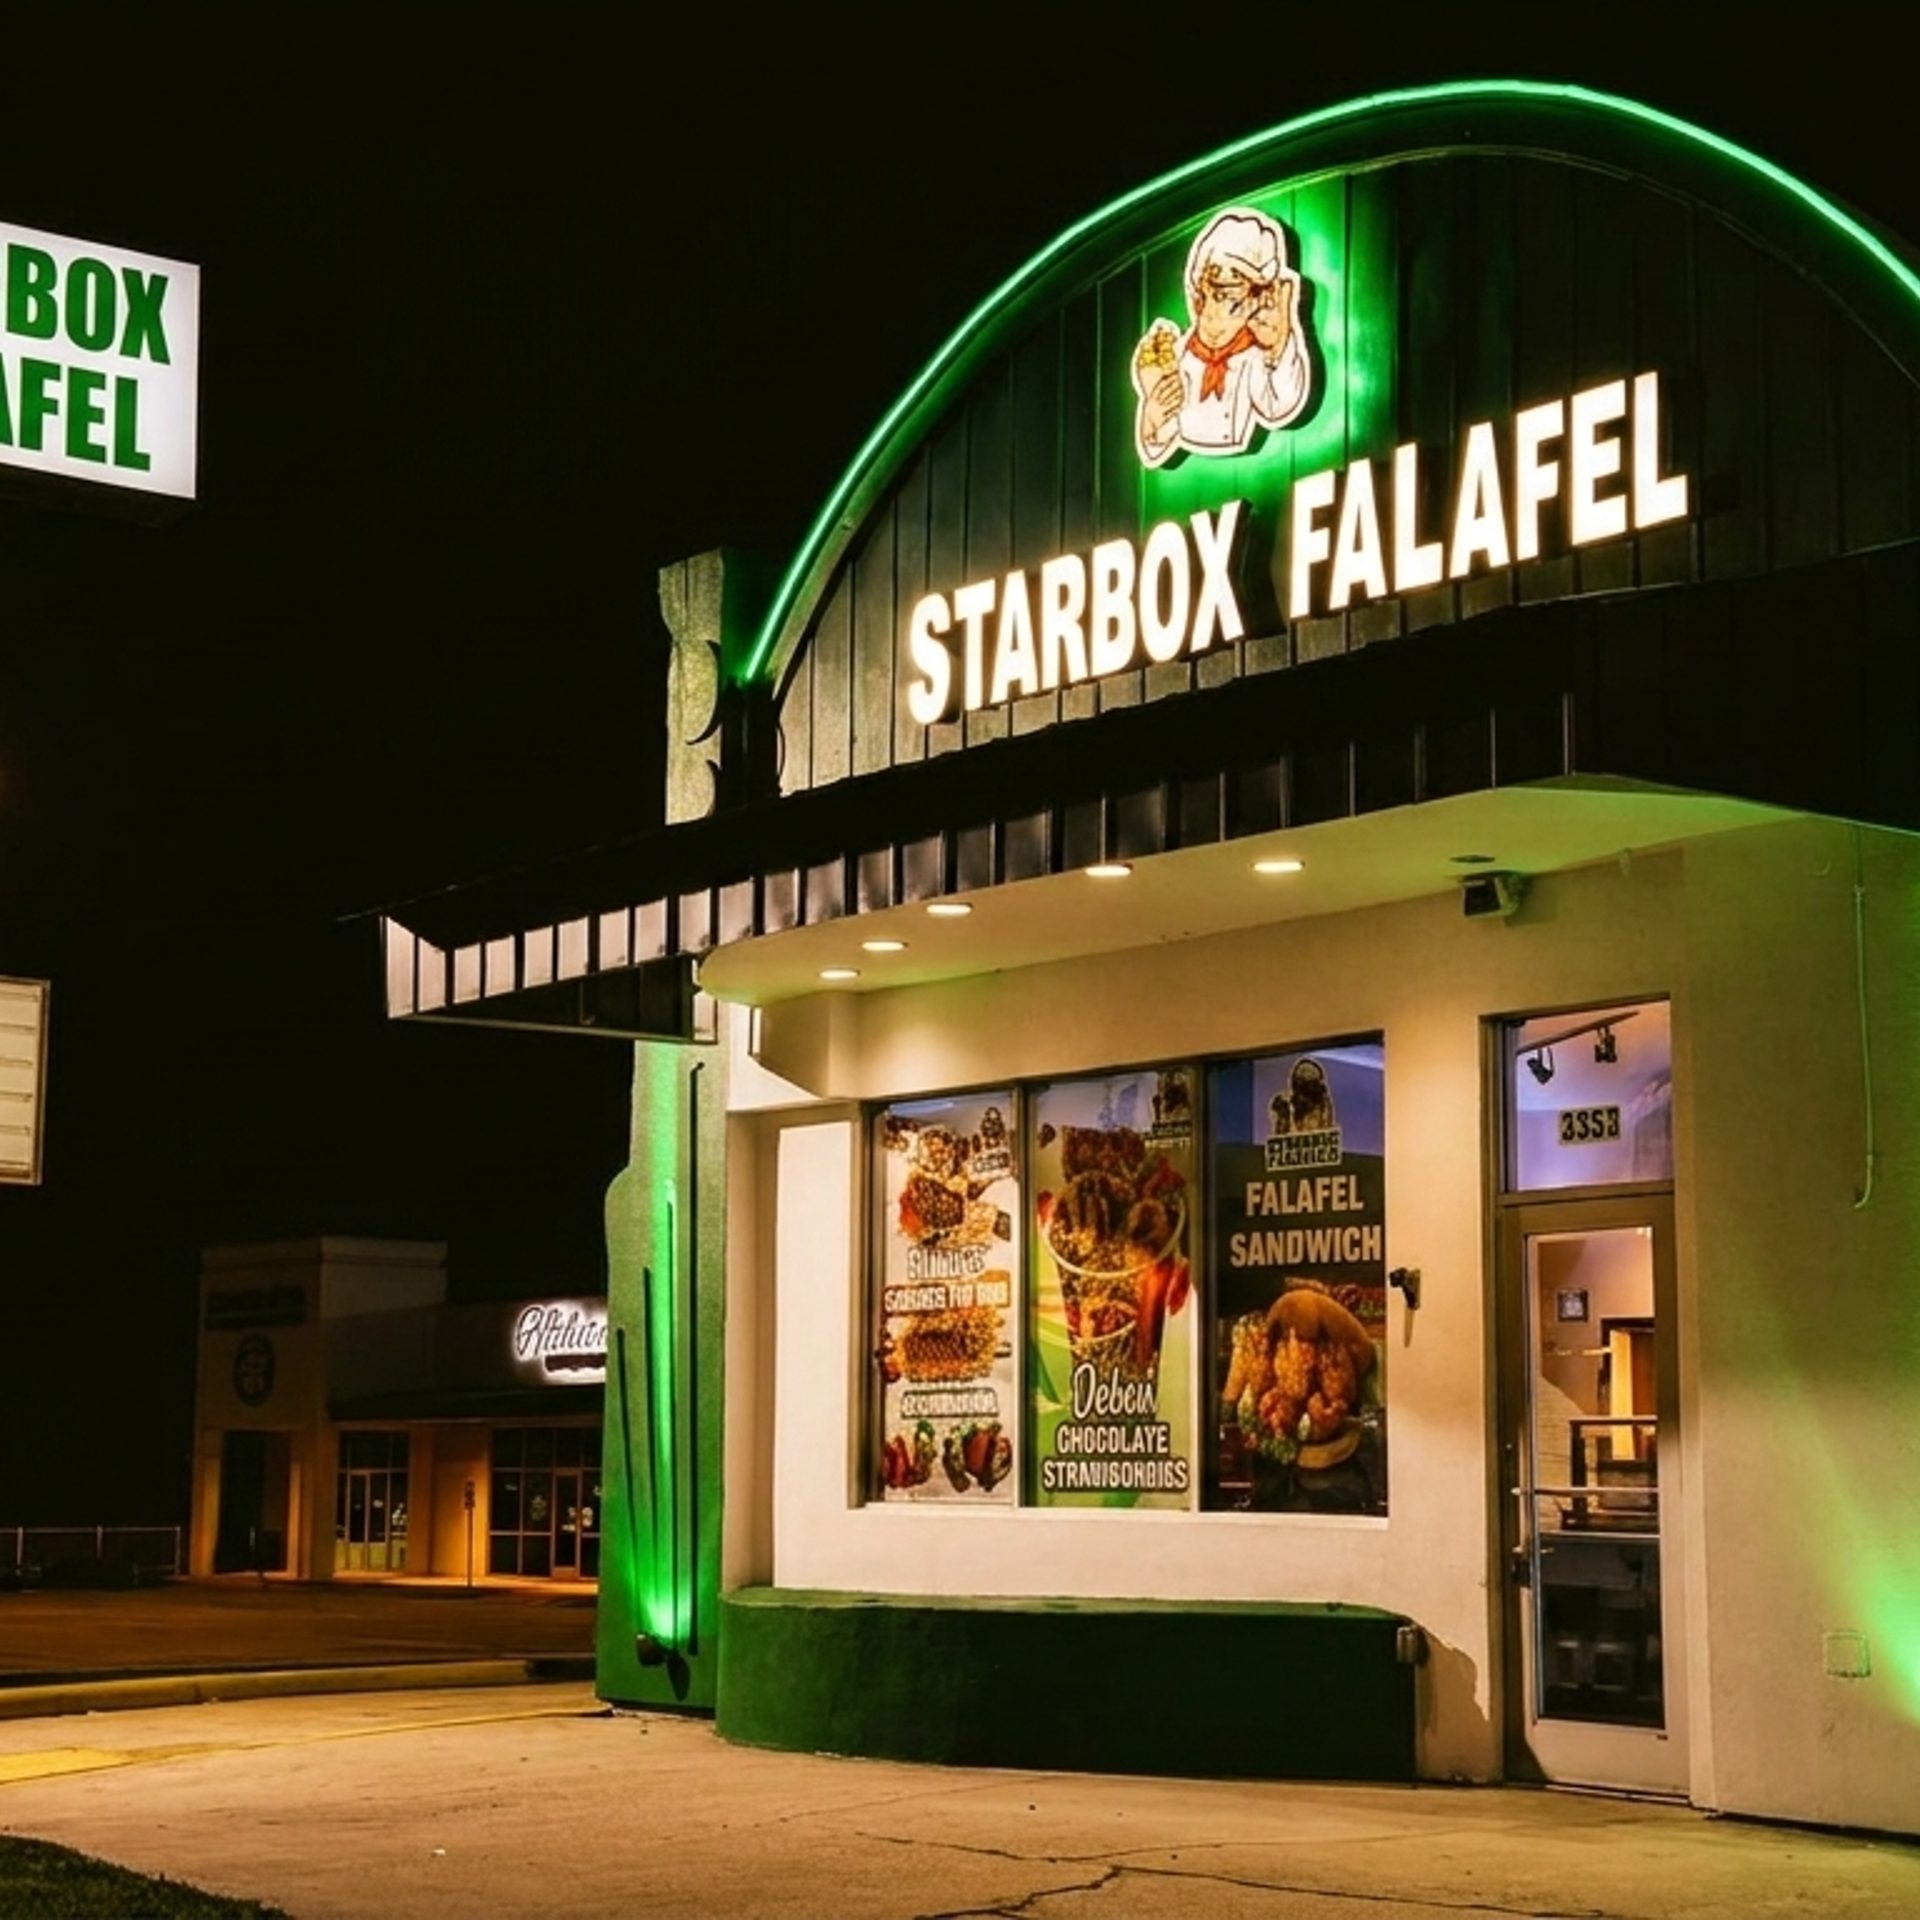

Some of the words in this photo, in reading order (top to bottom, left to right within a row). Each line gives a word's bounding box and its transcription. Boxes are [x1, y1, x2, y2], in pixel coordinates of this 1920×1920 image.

[6, 242, 171, 365] BOX
[907, 500, 1243, 725] STARBOX
[1289, 371, 1688, 619] FALAFEL
[1246, 1174, 1364, 1217] FALAFEL
[1230, 1225, 1382, 1268] SANDWICH
